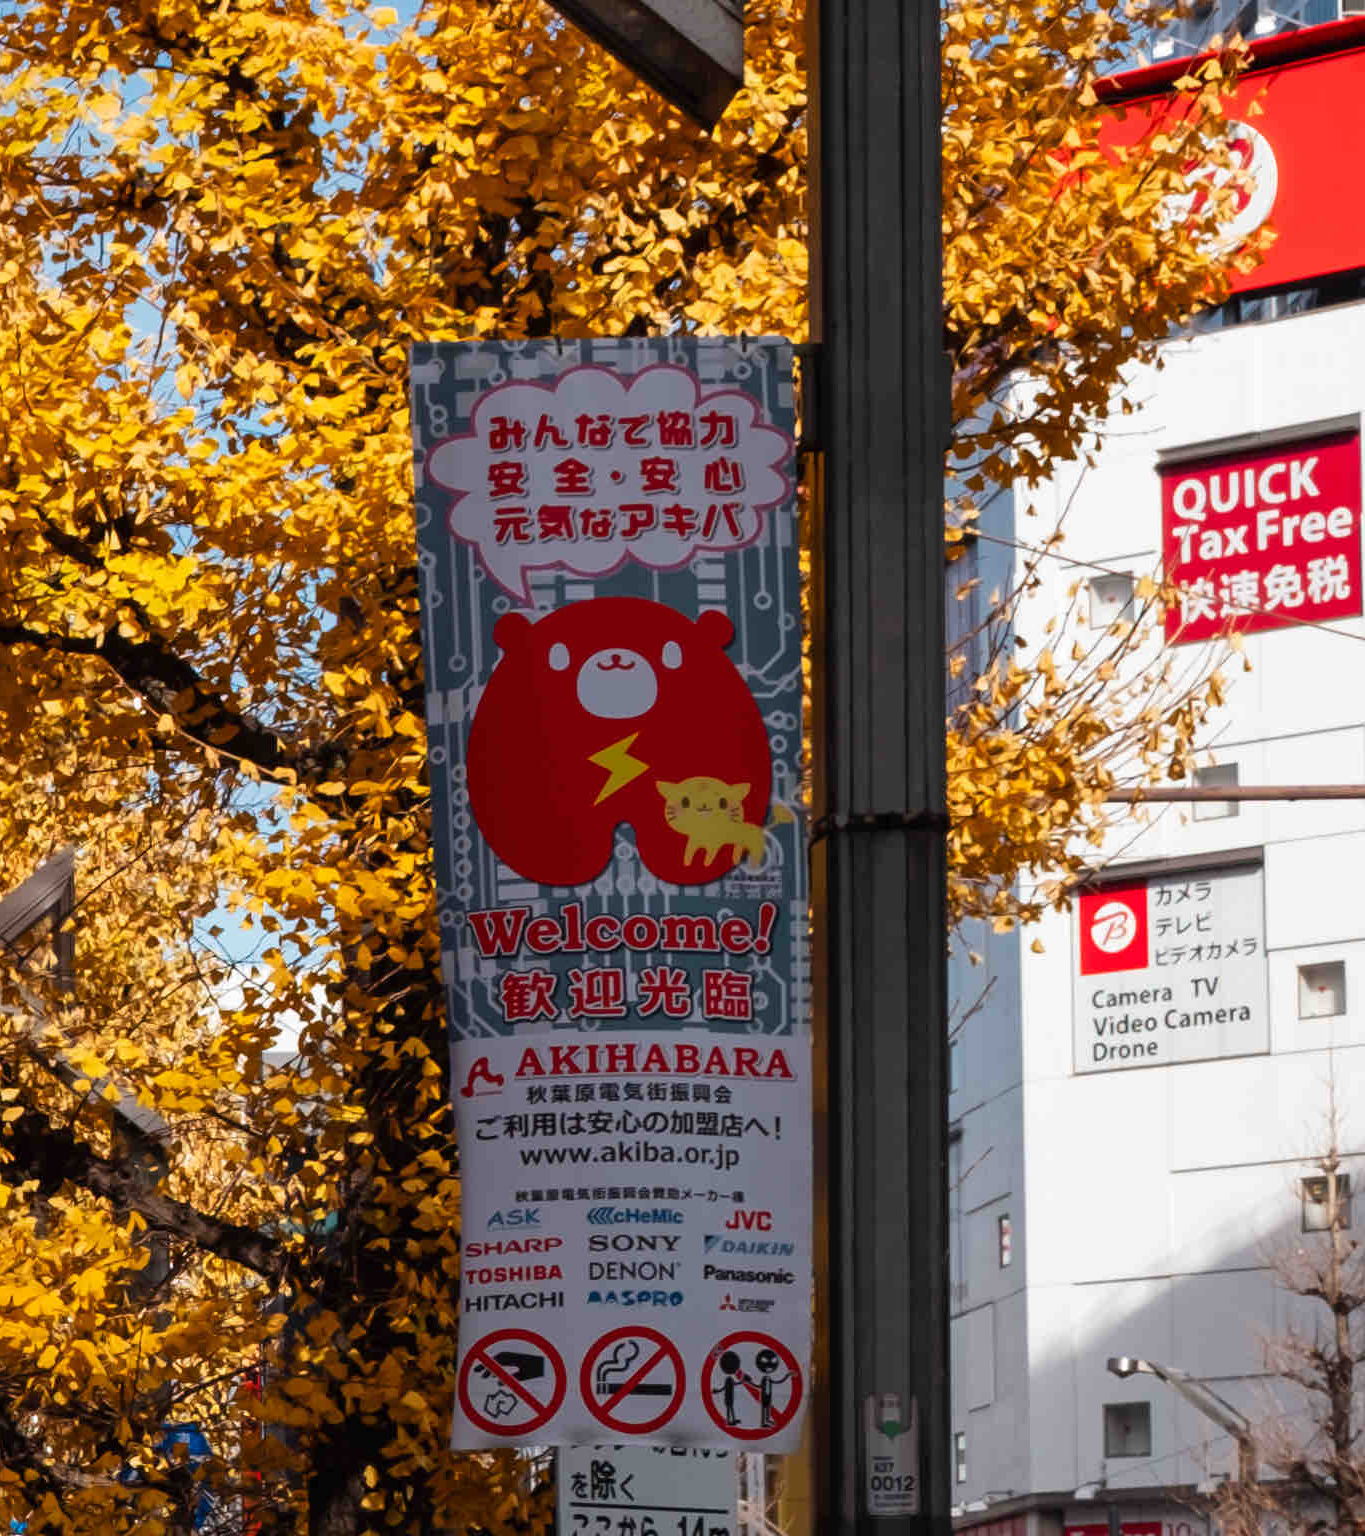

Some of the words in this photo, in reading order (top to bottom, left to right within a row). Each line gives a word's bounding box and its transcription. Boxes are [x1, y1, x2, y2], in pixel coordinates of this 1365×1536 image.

[489, 410, 737, 450] みんなで協力
[1172, 456, 1320, 521] QUICK
[494, 503, 743, 542] 元気なアキバ
[1172, 522, 1248, 565] Tax
[1256, 502, 1353, 556] Free
[1155, 880, 1213, 906] カメラ
[469, 902, 775, 956] Welcome!
[1155, 910, 1213, 937] テレビ
[1154, 937, 1258, 966] ビデオカメラ
[1091, 985, 1173, 1011] Camera
[1191, 977, 1219, 1000] TV
[1092, 1009, 1159, 1034] Video
[1163, 1001, 1251, 1030] Camera
[515, 1044, 795, 1078] AKIHABARA
[1092, 1036, 1159, 1062] Drone
[526, 1083, 732, 1105] 秋葉原電気街振興会
[520, 1141, 740, 1170] www.akiba.or.jp
[725, 1210, 773, 1232] JVC
[465, 1237, 564, 1258] SHARP
[588, 1234, 682, 1252] SONY
[721, 1240, 795, 1257] DAIKIN
[465, 1264, 563, 1285] TOSHIBA
[588, 1262, 676, 1281] DENON
[703, 1265, 797, 1284] Panasonic
[465, 1291, 565, 1313] HITACHI
[571, 1460, 635, 1501] を除く
[871, 1475, 915, 1491] 0012
